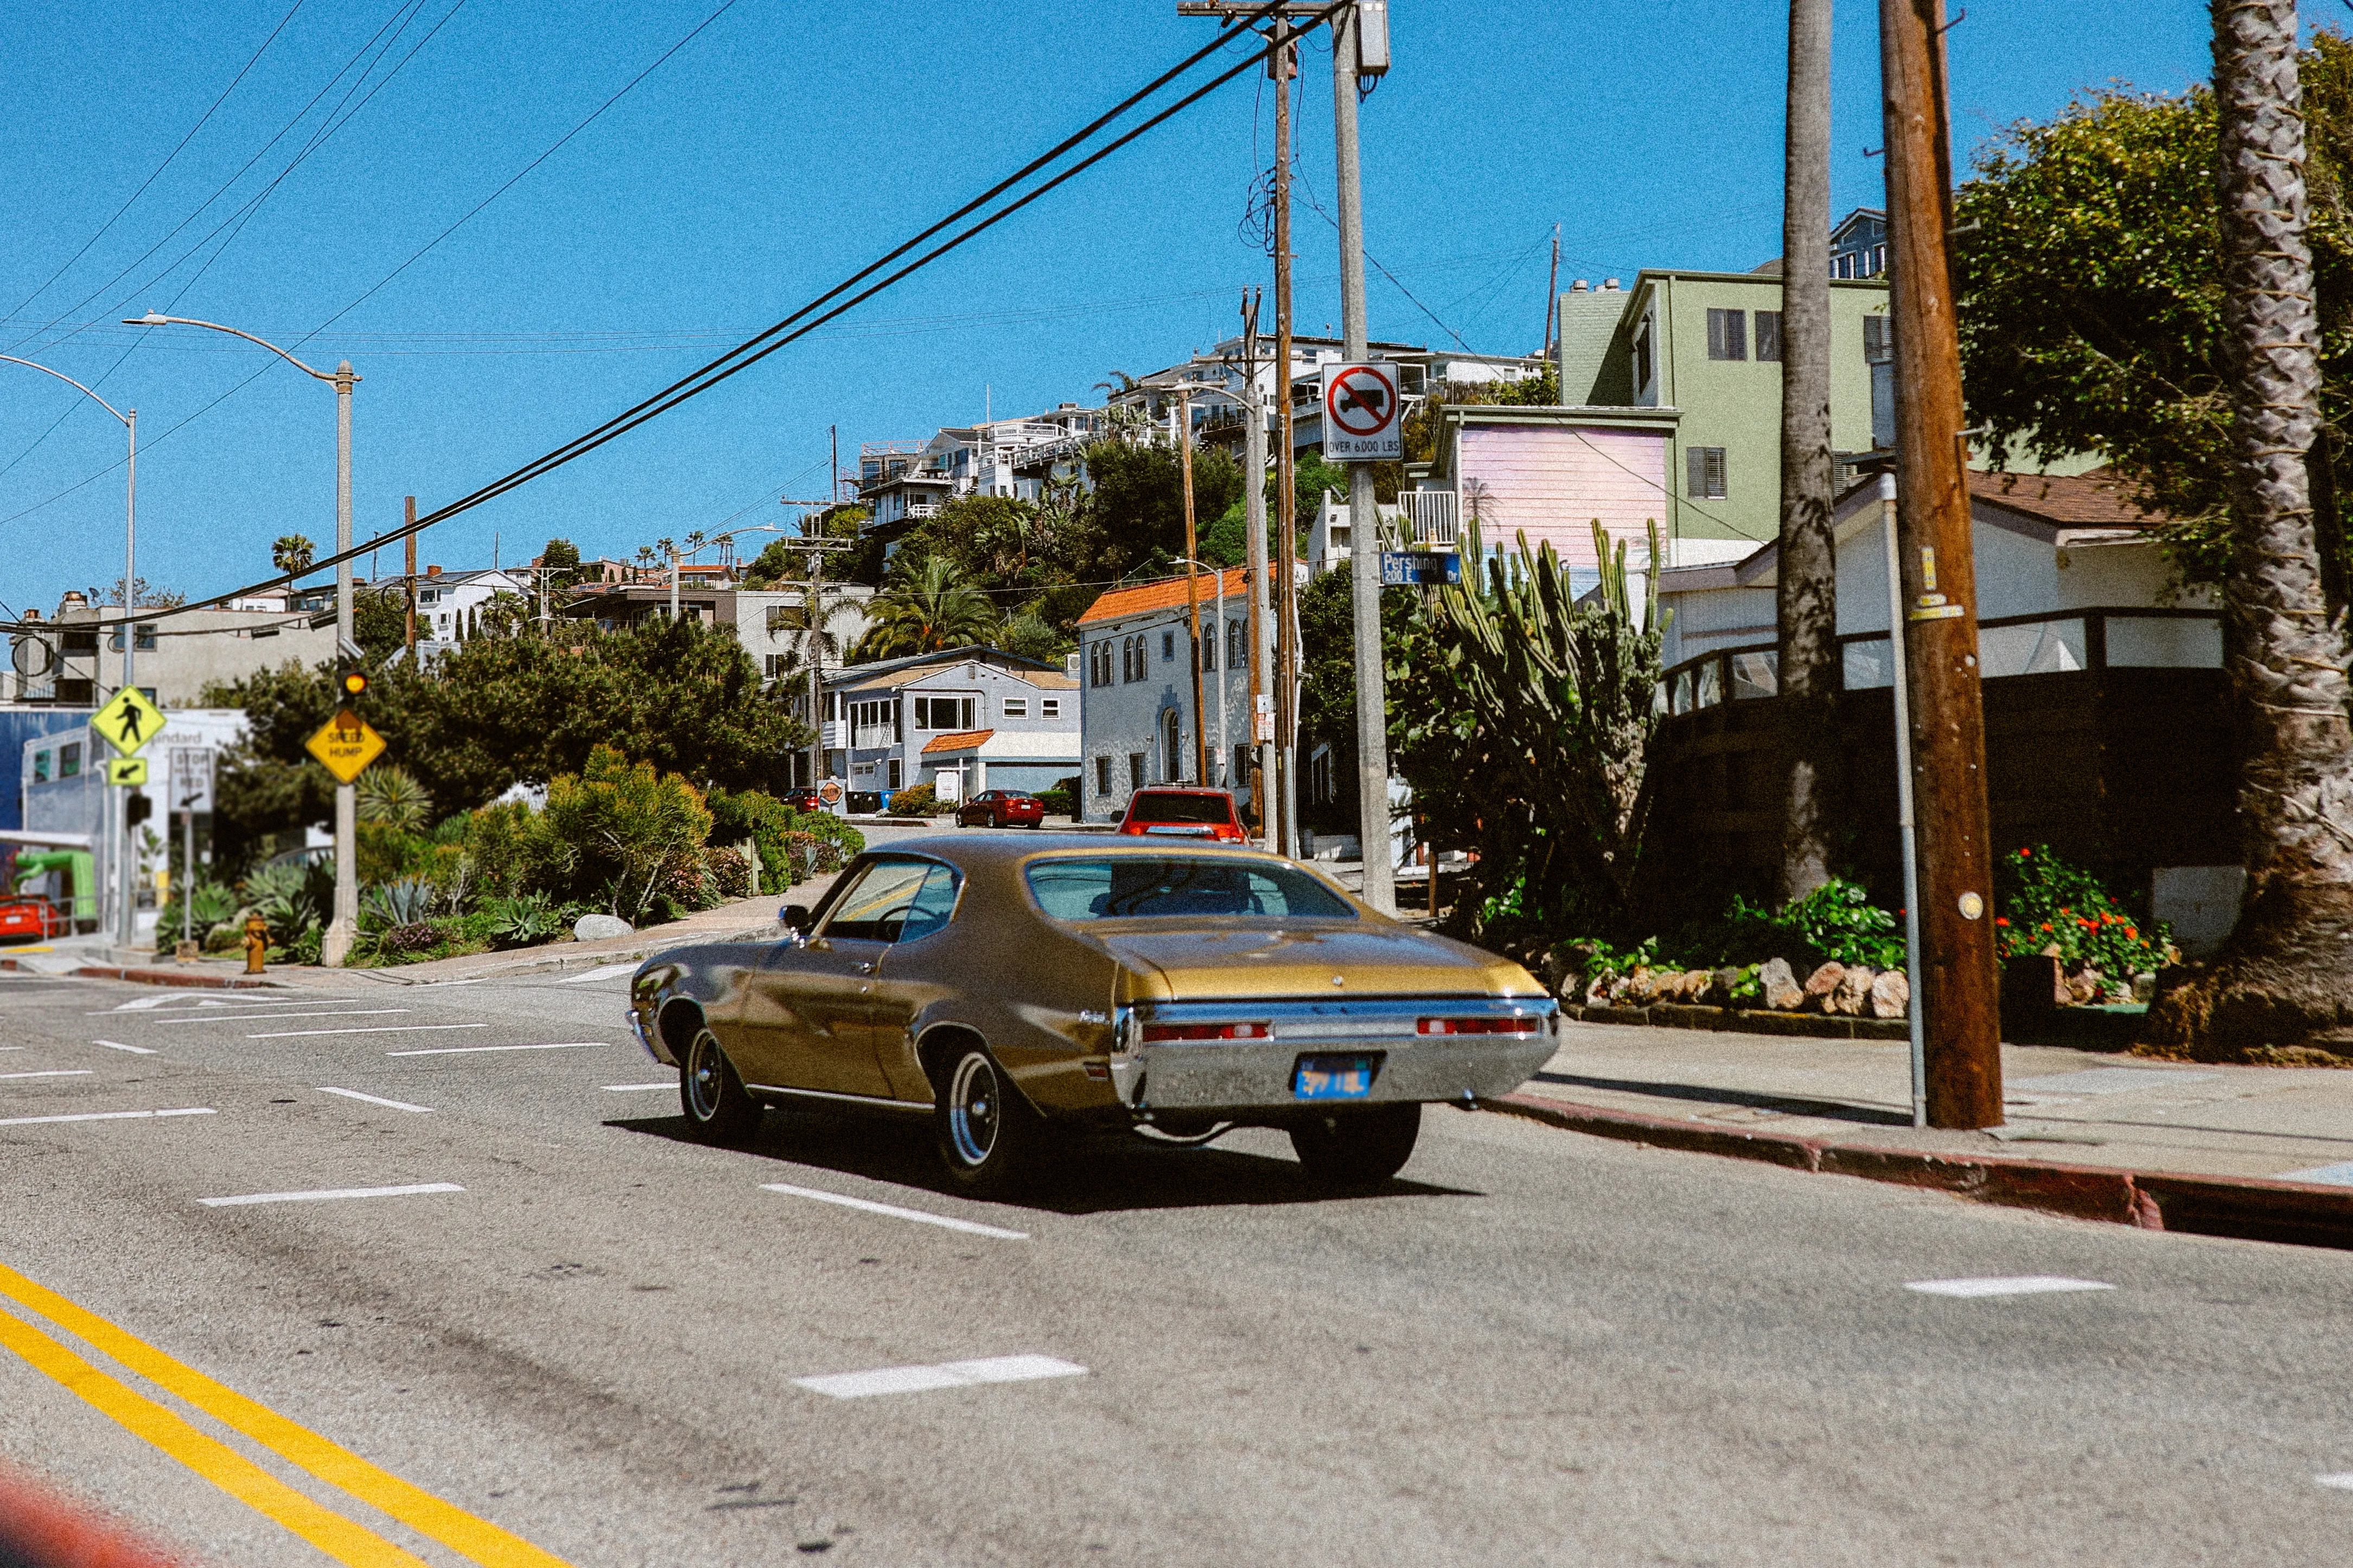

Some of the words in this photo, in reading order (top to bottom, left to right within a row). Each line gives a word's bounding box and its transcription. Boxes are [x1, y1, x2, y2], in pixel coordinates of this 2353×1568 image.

[1329, 441, 1350, 452] OVER
[1382, 441, 1399, 451] LBS
[1385, 554, 1437, 574] Pershing
[1385, 570, 1402, 581] 200
[1406, 571, 1413, 581] E
[1447, 570, 1458, 581] Dr
[328, 732, 365, 743] SPEED
[329, 747, 362, 758] HUMP
[177, 753, 209, 765] STOP
